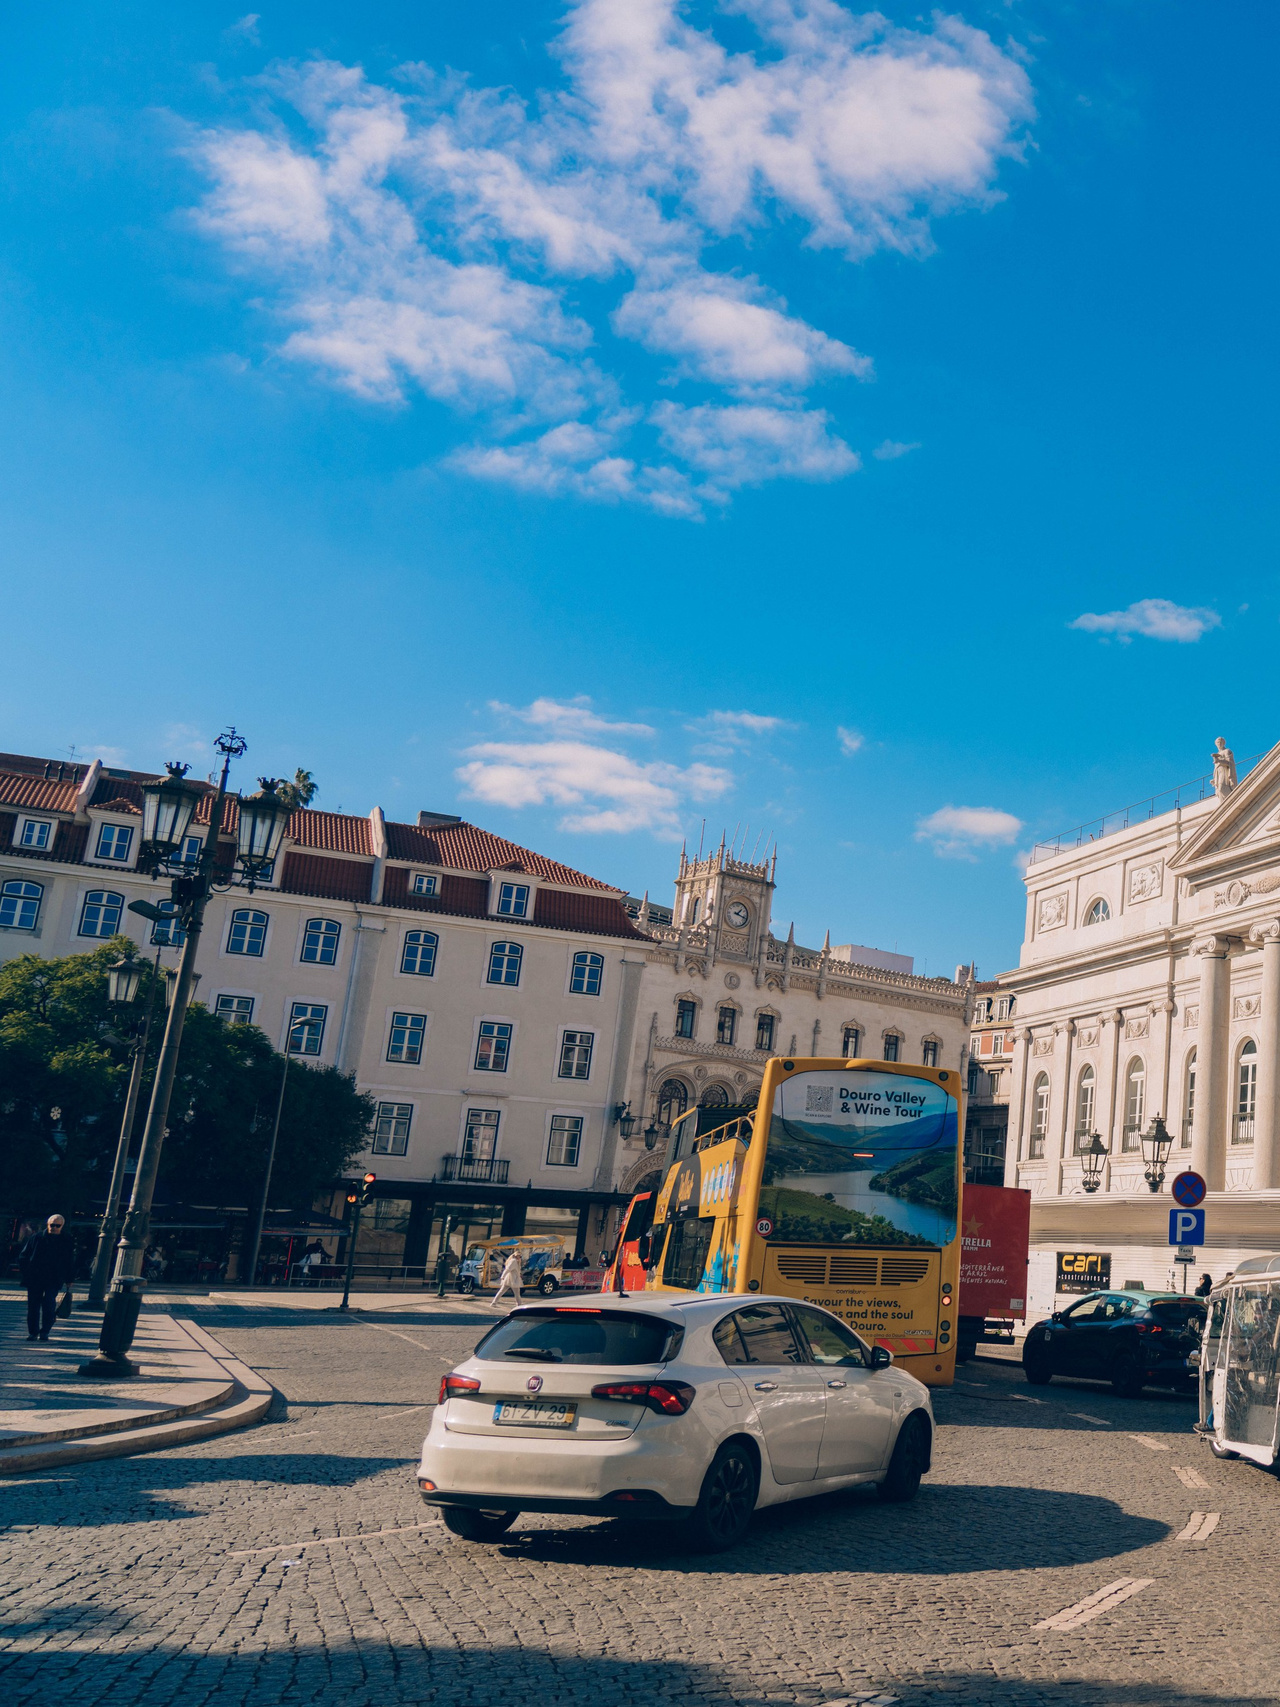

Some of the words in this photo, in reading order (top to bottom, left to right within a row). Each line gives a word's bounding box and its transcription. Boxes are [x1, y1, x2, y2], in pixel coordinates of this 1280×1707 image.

[839, 1087, 881, 1101] Douro
[885, 1090, 927, 1107] Valley
[841, 1102, 850, 1114] &
[854, 1102, 891, 1116] Wine
[894, 1105, 923, 1118] Tour
[758, 1222, 770, 1231] 80
[1176, 1212, 1198, 1242] P
[961, 1237, 992, 1248] TRELLA
[1061, 1254, 1102, 1273] cari
[803, 1296, 843, 1307] Savour
[846, 1297, 864, 1307] the
[867, 1297, 901, 1309] views,
[846, 1308, 868, 1319] and
[870, 1309, 889, 1319] the
[891, 1310, 914, 1320] soul
[850, 1321, 887, 1331] Douro.
